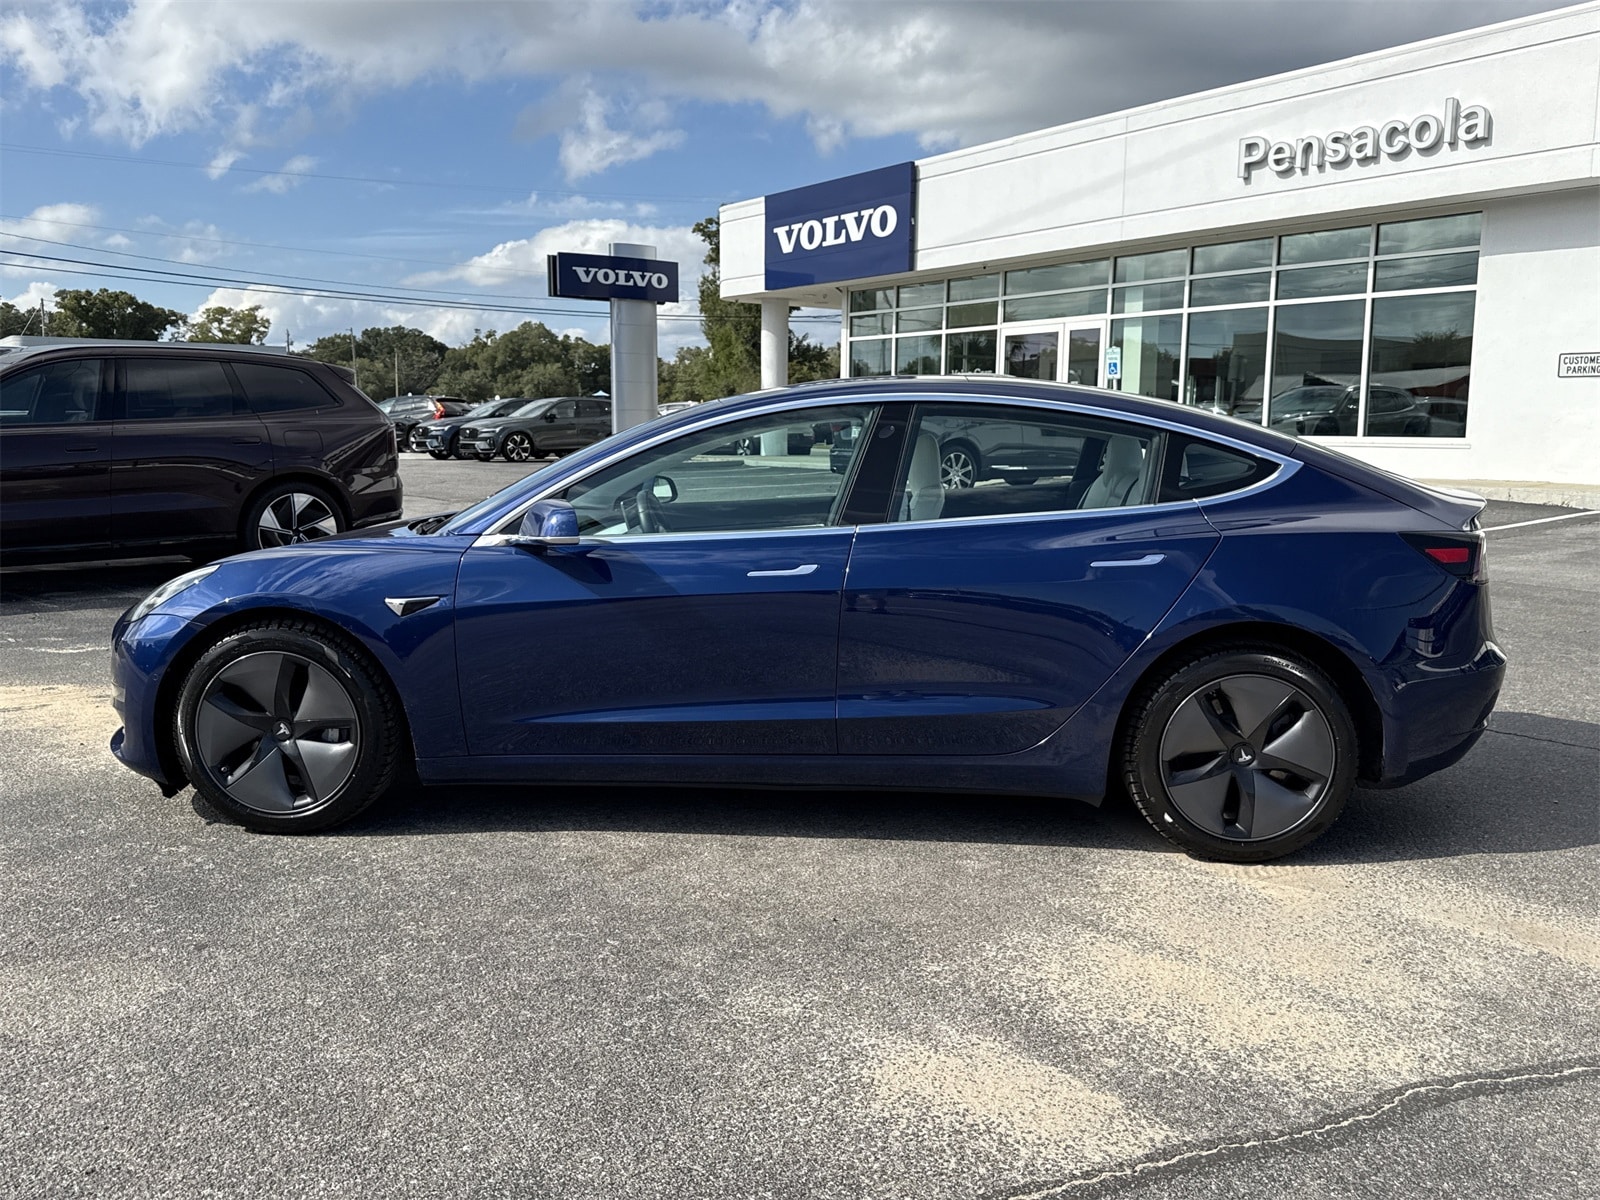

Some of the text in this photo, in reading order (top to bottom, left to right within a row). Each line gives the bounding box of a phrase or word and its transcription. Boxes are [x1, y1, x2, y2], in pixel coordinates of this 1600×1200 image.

[1237, 97, 1491, 180] Pensacola
[773, 204, 898, 254] VOLVO
[572, 266, 669, 289] VOLVO
[1566, 365, 1600, 374] PARKING
